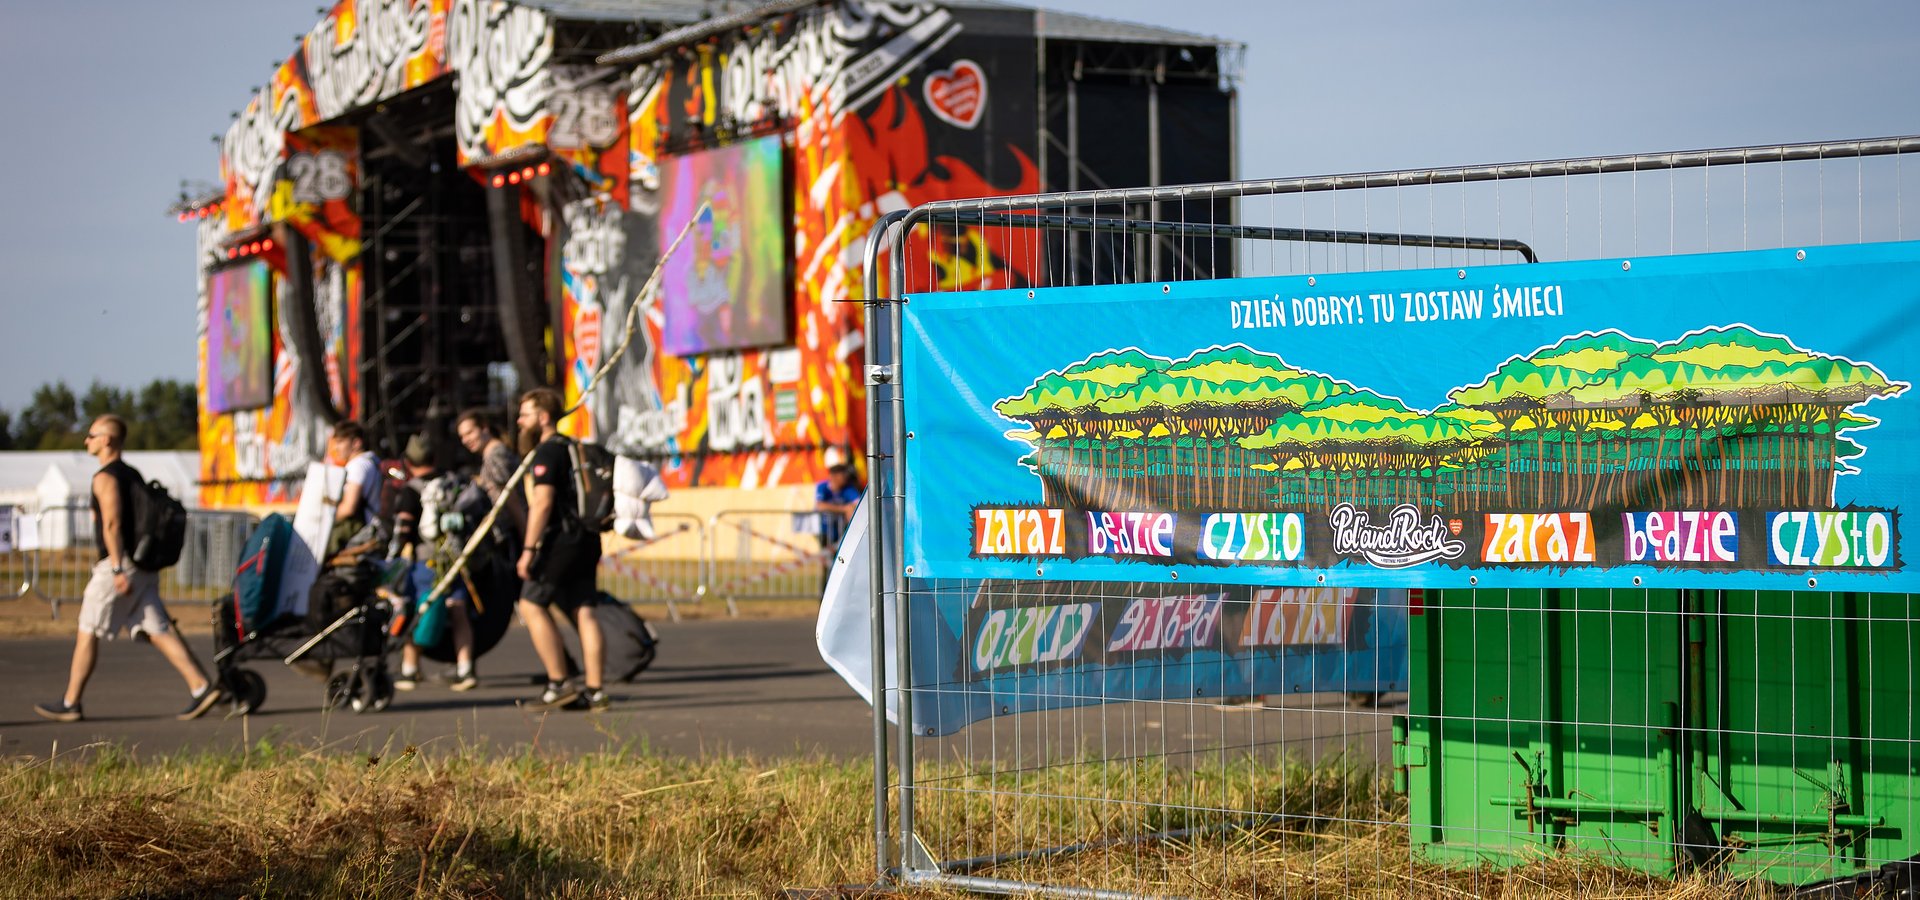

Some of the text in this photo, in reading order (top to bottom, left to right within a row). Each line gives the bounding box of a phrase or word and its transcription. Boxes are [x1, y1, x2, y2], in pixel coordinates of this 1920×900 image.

[1230, 283, 1564, 328] DZIEŃ DOBRY! TU ZOSTAW ŚMIECI
[978, 509, 1302, 561] zaraz będzie czysto
[1486, 511, 1892, 567] zaraz będzie czysto
